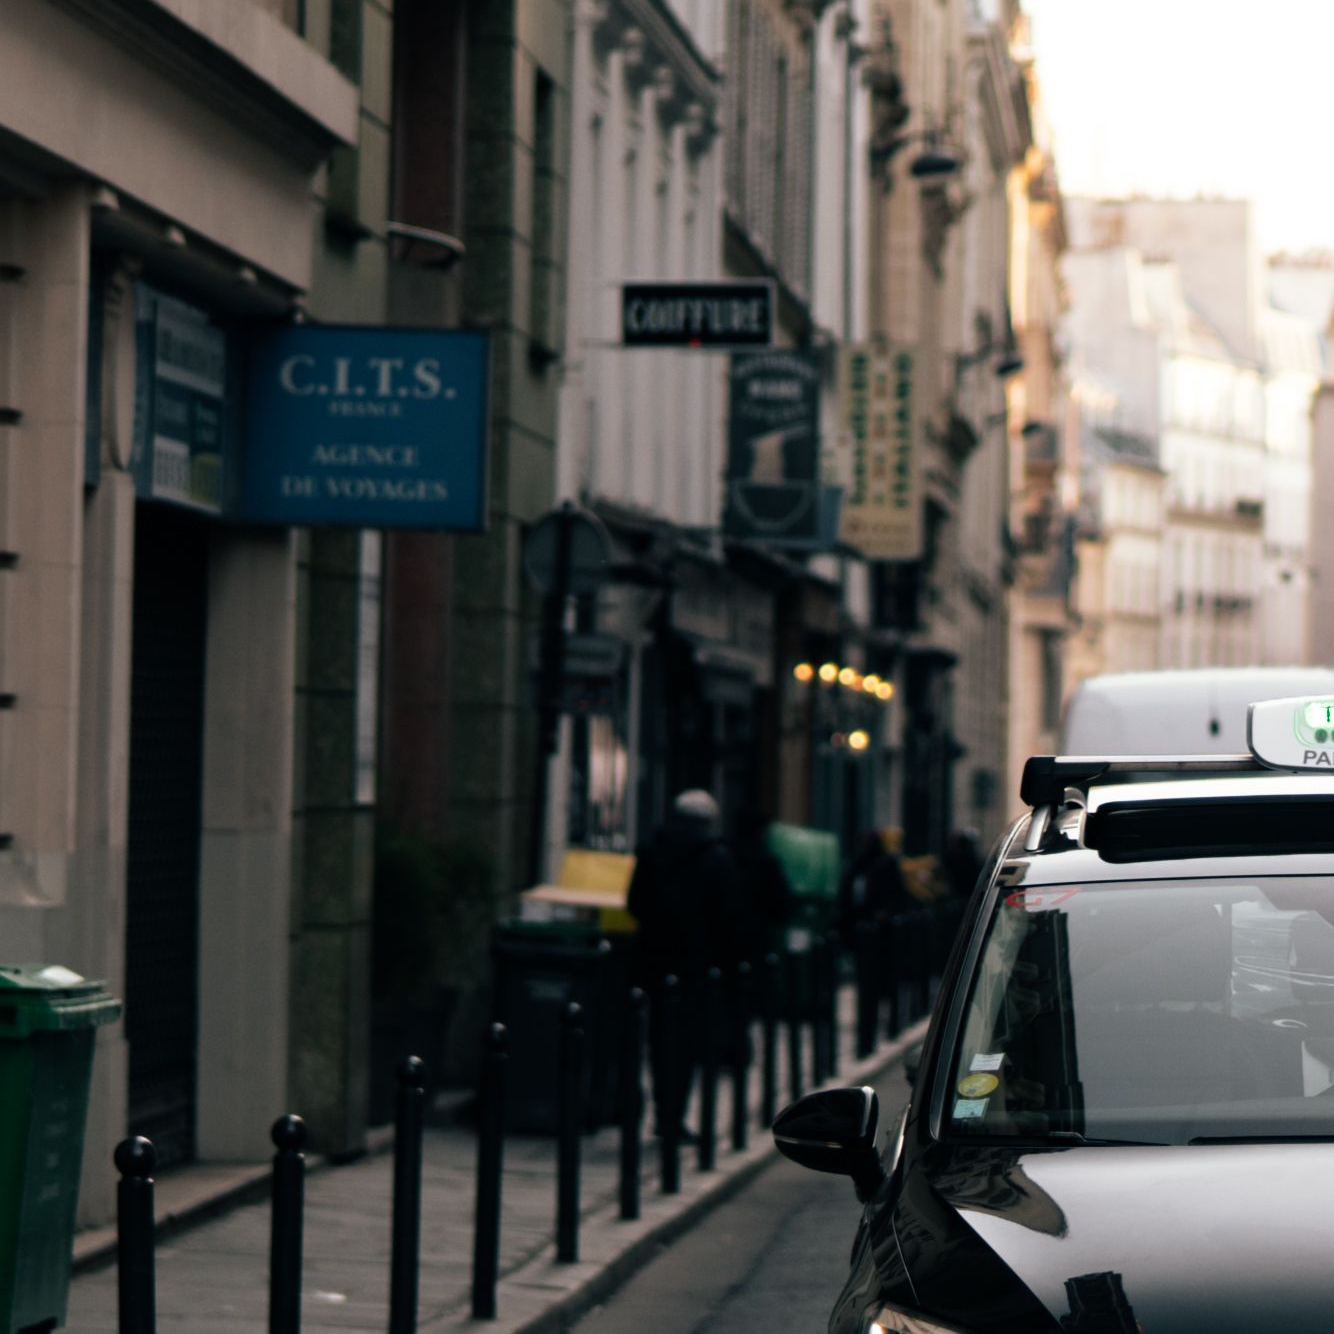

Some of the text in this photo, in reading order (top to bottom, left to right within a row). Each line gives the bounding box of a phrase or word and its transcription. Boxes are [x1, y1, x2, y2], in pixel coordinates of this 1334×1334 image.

[627, 298, 763, 333] COIFFURE
[279, 354, 458, 400] C.I.T.S.
[328, 400, 402, 418] FRANCE
[311, 443, 420, 467] AGENCE
[281, 475, 448, 501] DE VOYAGES
